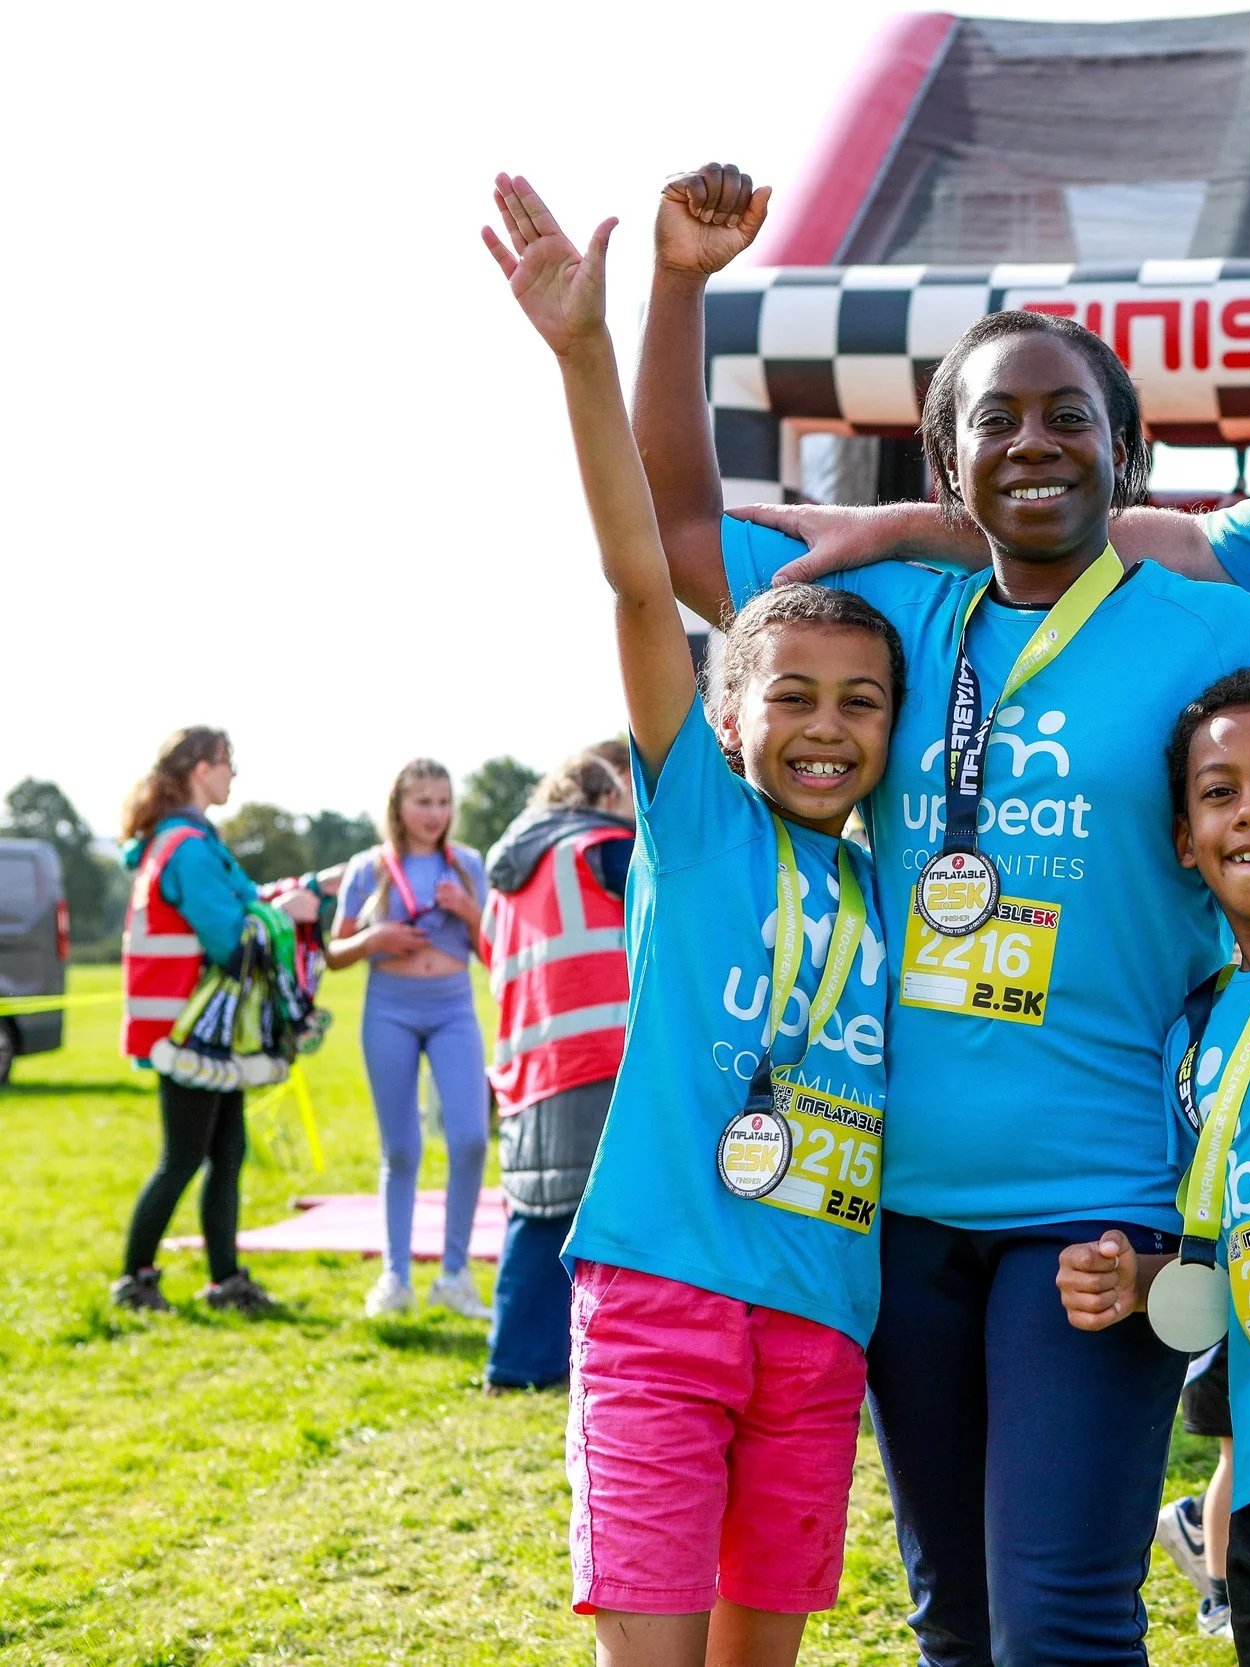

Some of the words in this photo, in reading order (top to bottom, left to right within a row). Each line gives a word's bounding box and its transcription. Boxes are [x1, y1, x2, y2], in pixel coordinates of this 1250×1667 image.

[902, 848, 1086, 880] CONITIES
[929, 870, 986, 880] INFLATABLE
[927, 881, 987, 911] 2.5K
[915, 925, 1033, 979] 2216
[972, 982, 1045, 1017] 2.5K
[794, 1094, 884, 1138] INFLATABLE
[730, 1131, 780, 1142] INFLATABLE
[825, 1189, 876, 1227] 2.5K
